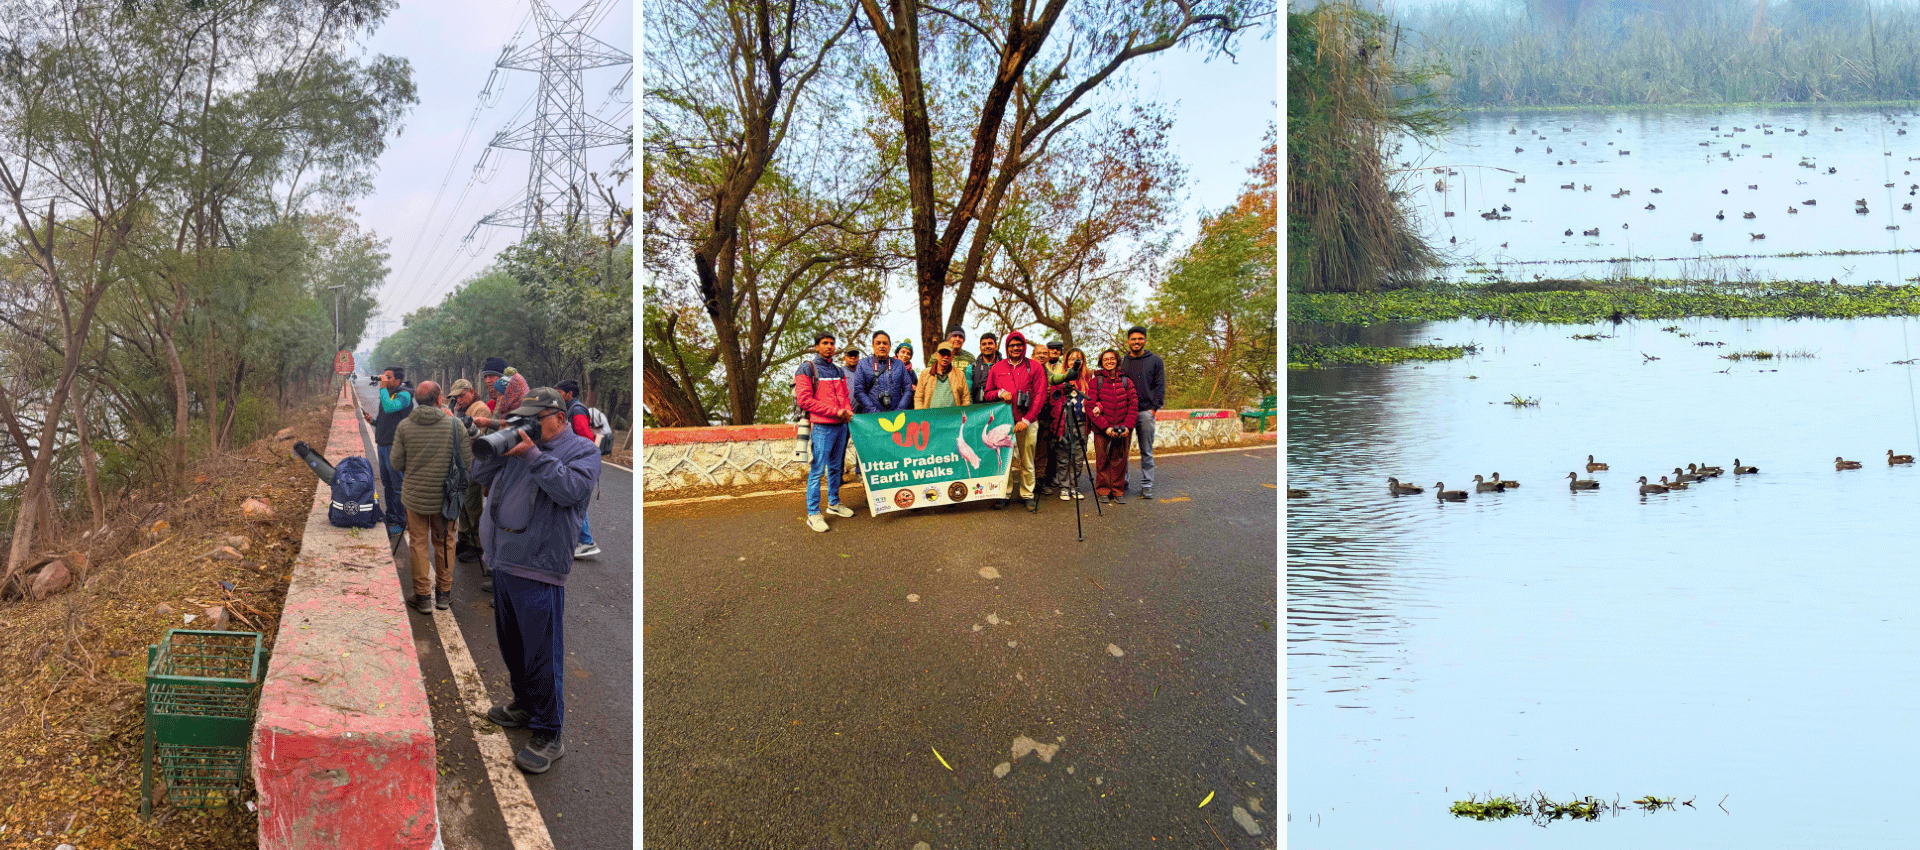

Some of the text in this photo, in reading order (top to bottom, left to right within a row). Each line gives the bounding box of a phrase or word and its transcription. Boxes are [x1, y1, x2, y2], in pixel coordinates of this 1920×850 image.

[862, 452, 959, 472] Uttar Pradesh
[871, 467, 953, 485] Earth Walks
